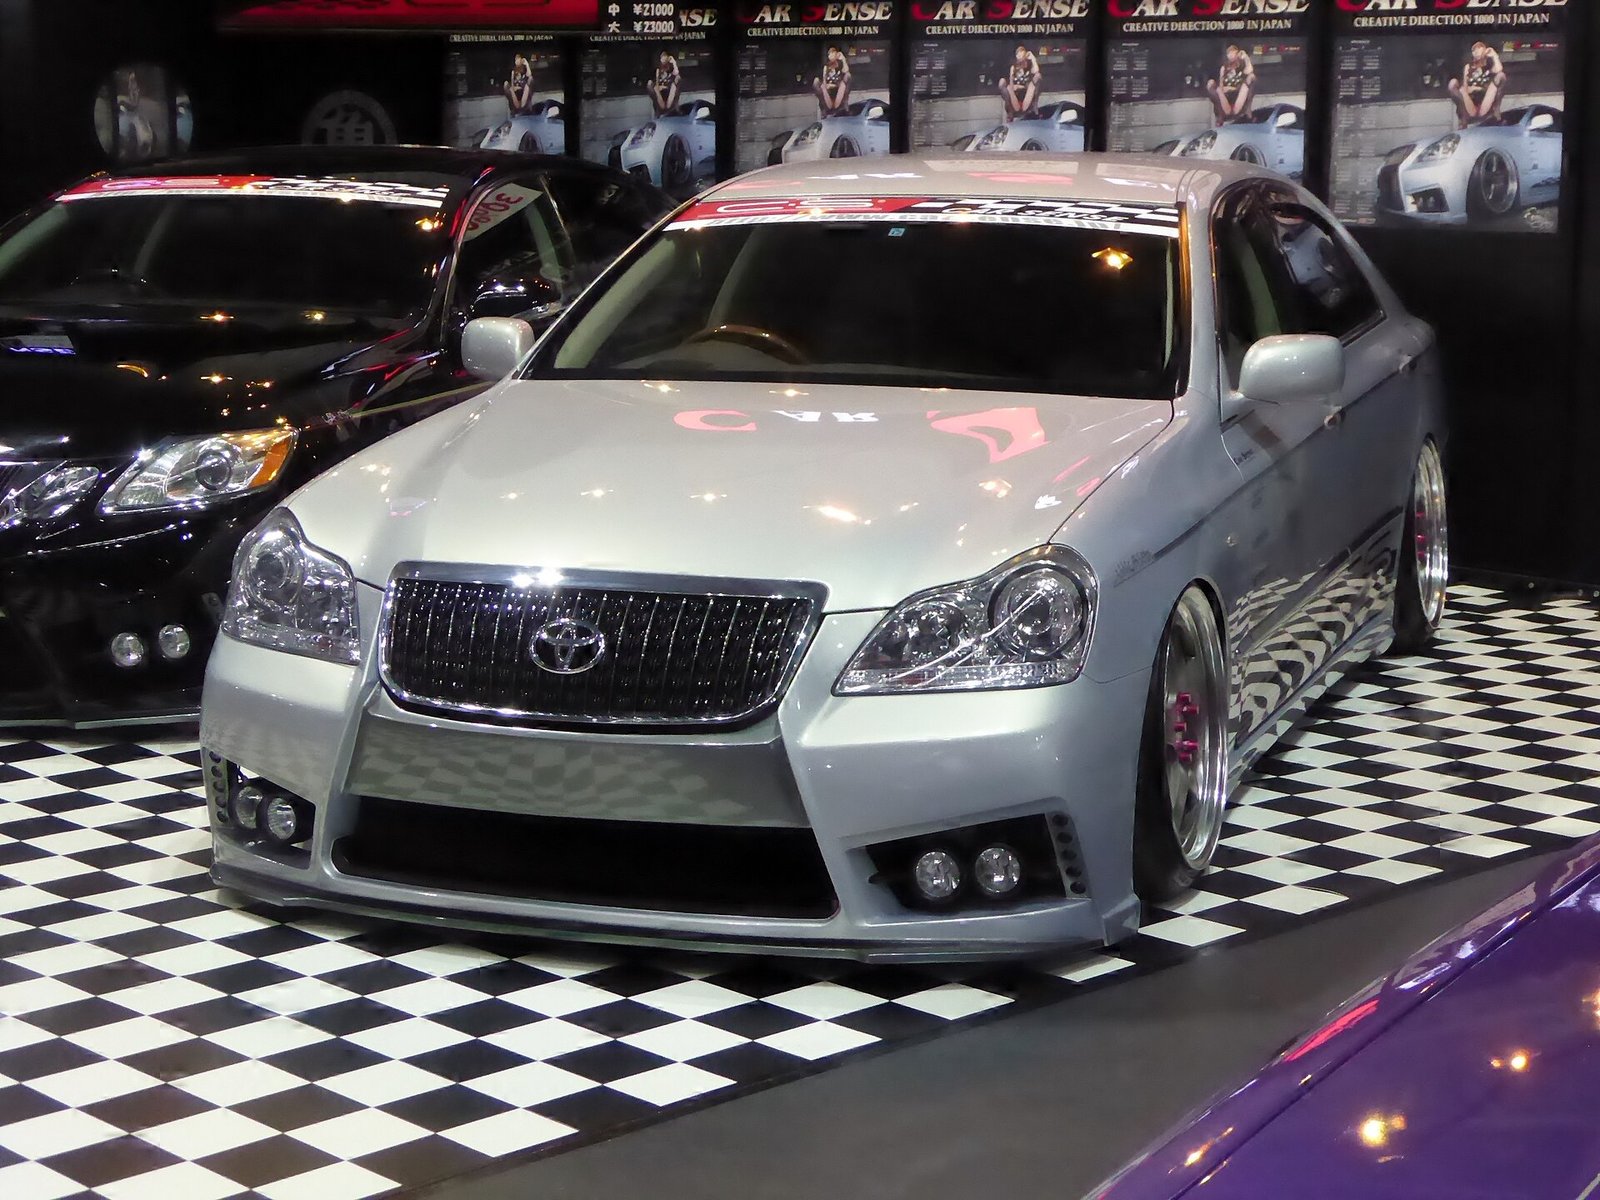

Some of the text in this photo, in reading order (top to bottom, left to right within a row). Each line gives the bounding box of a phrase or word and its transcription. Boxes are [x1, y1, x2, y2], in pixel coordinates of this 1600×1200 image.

[608, 3, 674, 16] 中 ¥21000
[986, 0, 1089, 20] SENSE
[608, 20, 674, 33] 大 ¥23000
[1123, 21, 1169, 33] CREATIVE
[1170, 20, 1225, 32] DIRECTION
[1247, 19, 1258, 29] IN
[1259, 19, 1292, 32] JAPAN
[1354, 16, 1408, 28] CREATIVE
[1409, 14, 1472, 27] DIRECTION
[1498, 13, 1512, 24] IN
[1513, 13, 1550, 26] JAPAN
[747, 28, 784, 37] CREATIVE
[784, 27, 828, 36] DIRECTION
[844, 26, 855, 35] IN
[854, 26, 879, 36] JAPAN
[926, 25, 966, 35] CREATIVE
[967, 24, 1016, 34] DIRECTION
[1034, 24, 1046, 33] IN
[1046, 23, 1074, 35] JAPAN
